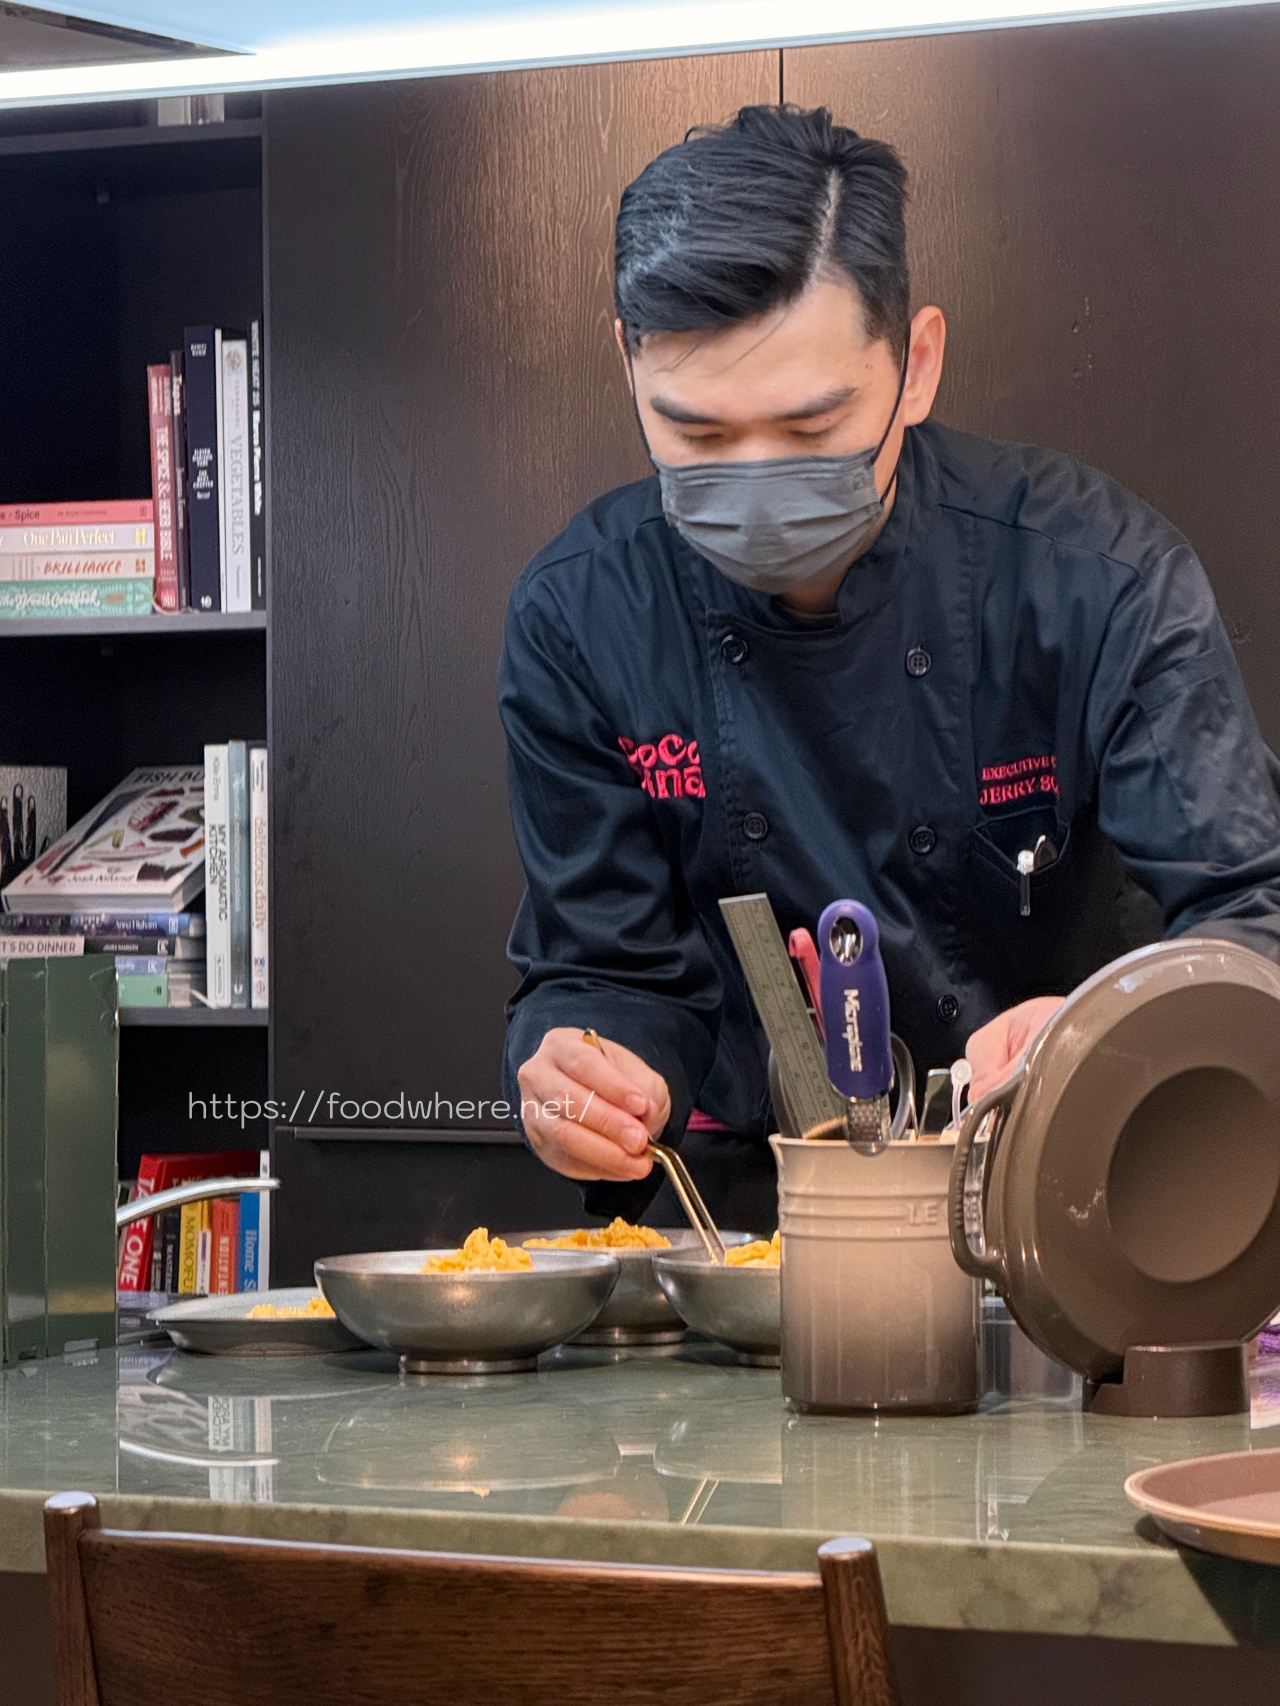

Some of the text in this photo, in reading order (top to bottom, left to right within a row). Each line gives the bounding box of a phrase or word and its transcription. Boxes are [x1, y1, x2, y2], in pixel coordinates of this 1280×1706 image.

[156, 425, 169, 447] THE
[157, 448, 170, 481] SPICE
[230, 434, 244, 556] VEGETABLES
[15, 508, 40, 523] Spice
[158, 498, 171, 527] HERB
[23, 531, 48, 547] One
[51, 529, 72, 546] Pan
[75, 528, 115, 546] Perfect
[160, 529, 173, 562] BIBLE
[44, 559, 122, 576] BRILLIANCE
[982, 756, 1049, 780] EXECUTIVE
[980, 776, 1036, 805] JERRY
[209, 824, 217, 885] KITCHEN
[217, 824, 228, 922] MY AROMATIC
[18, 941, 35, 954] DO
[37, 940, 76, 953] DINNER
[131, 1176, 155, 1231] TAE
[120, 1235, 143, 1290] ONE
[183, 1216, 195, 1293] MOMOFU
[245, 1228, 258, 1273] Home
